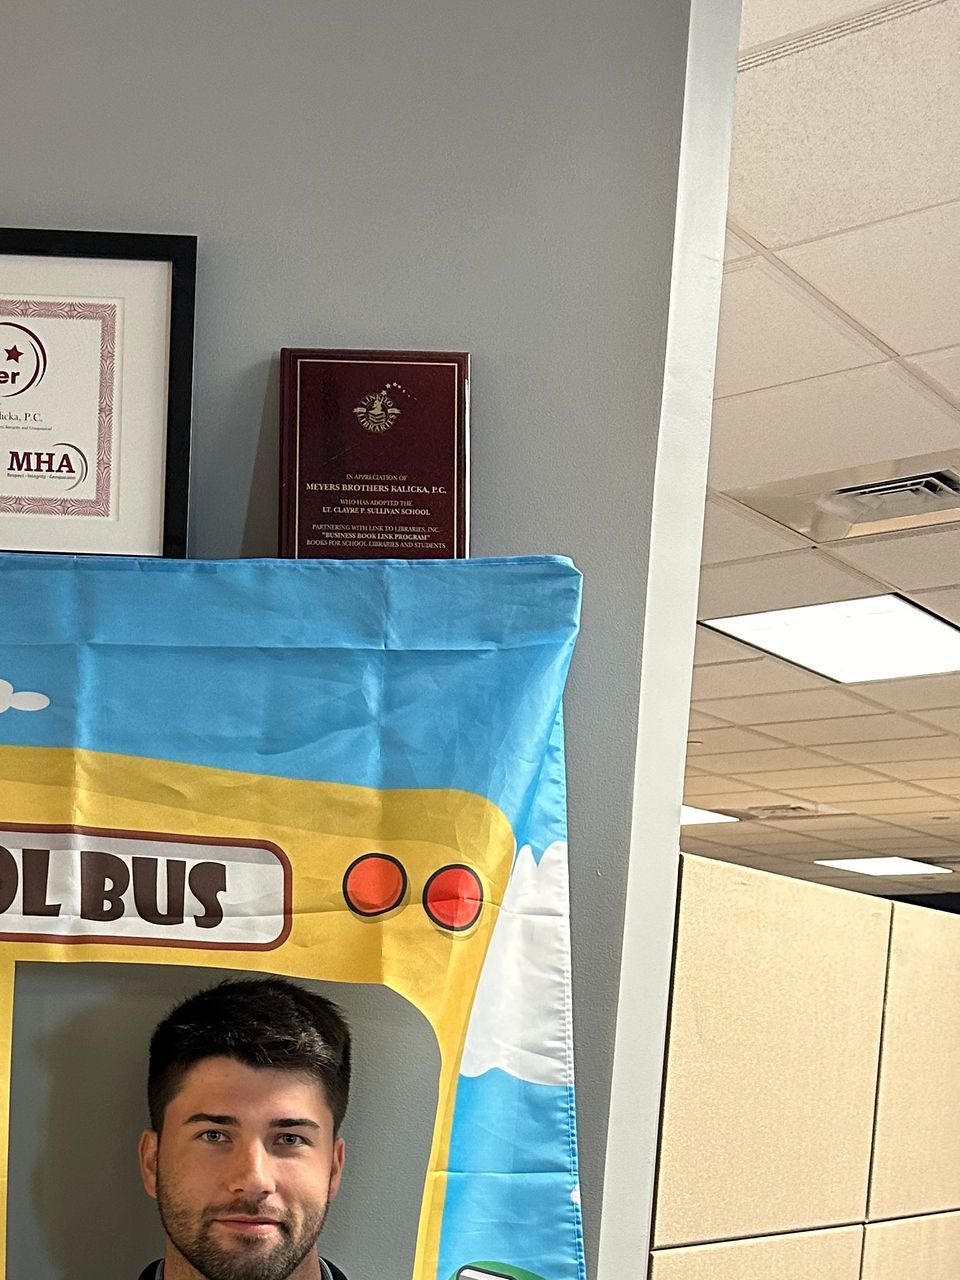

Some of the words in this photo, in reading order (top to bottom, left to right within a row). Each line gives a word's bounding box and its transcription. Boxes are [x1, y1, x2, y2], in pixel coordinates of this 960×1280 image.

[24, 413, 43, 422] P.C.
[357, 413, 397, 432] LIBRARIES
[7, 451, 75, 473] MHA
[306, 483, 340, 491] MEYERS
[342, 484, 390, 492] BROTHERS
[391, 485, 430, 494] KALICKA,
[432, 486, 447, 494] P.C.
[80, 850, 228, 929] BUS
